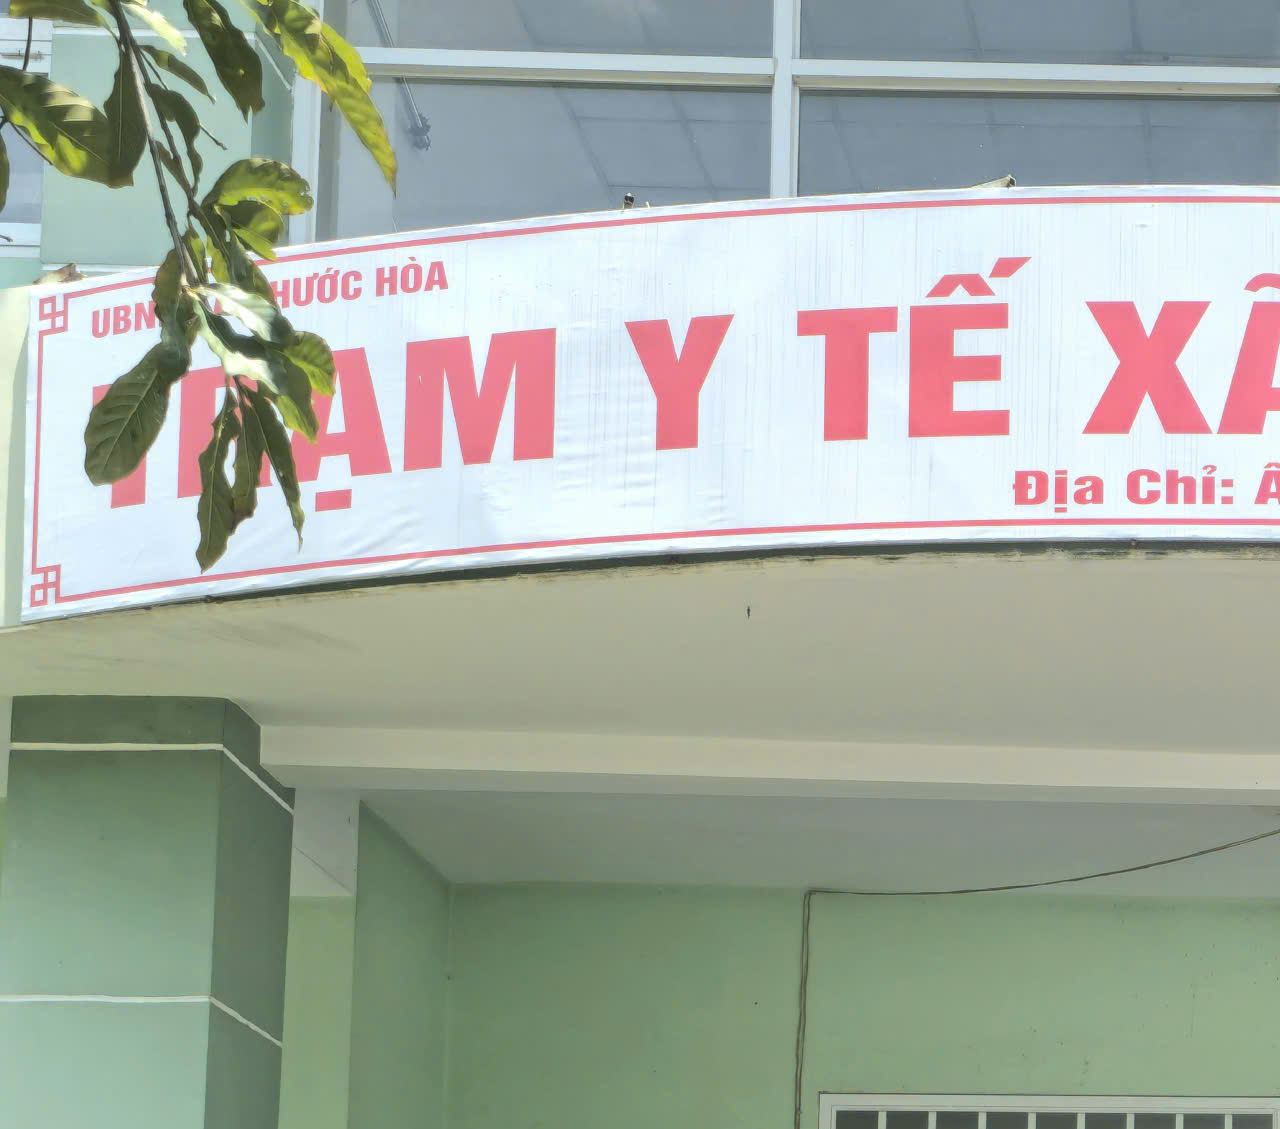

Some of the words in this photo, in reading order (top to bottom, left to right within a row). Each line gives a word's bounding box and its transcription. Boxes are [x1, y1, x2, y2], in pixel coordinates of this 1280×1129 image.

[92, 301, 172, 339] UBN
[262, 267, 363, 309] HƯỚC
[375, 256, 449, 298] HÒA
[92, 327, 556, 513] RẠM
[625, 313, 735, 451] Y
[797, 256, 1032, 442] TẾ
[1012, 469, 1104, 513] Địa
[1126, 464, 1234, 505] Chỉ:
